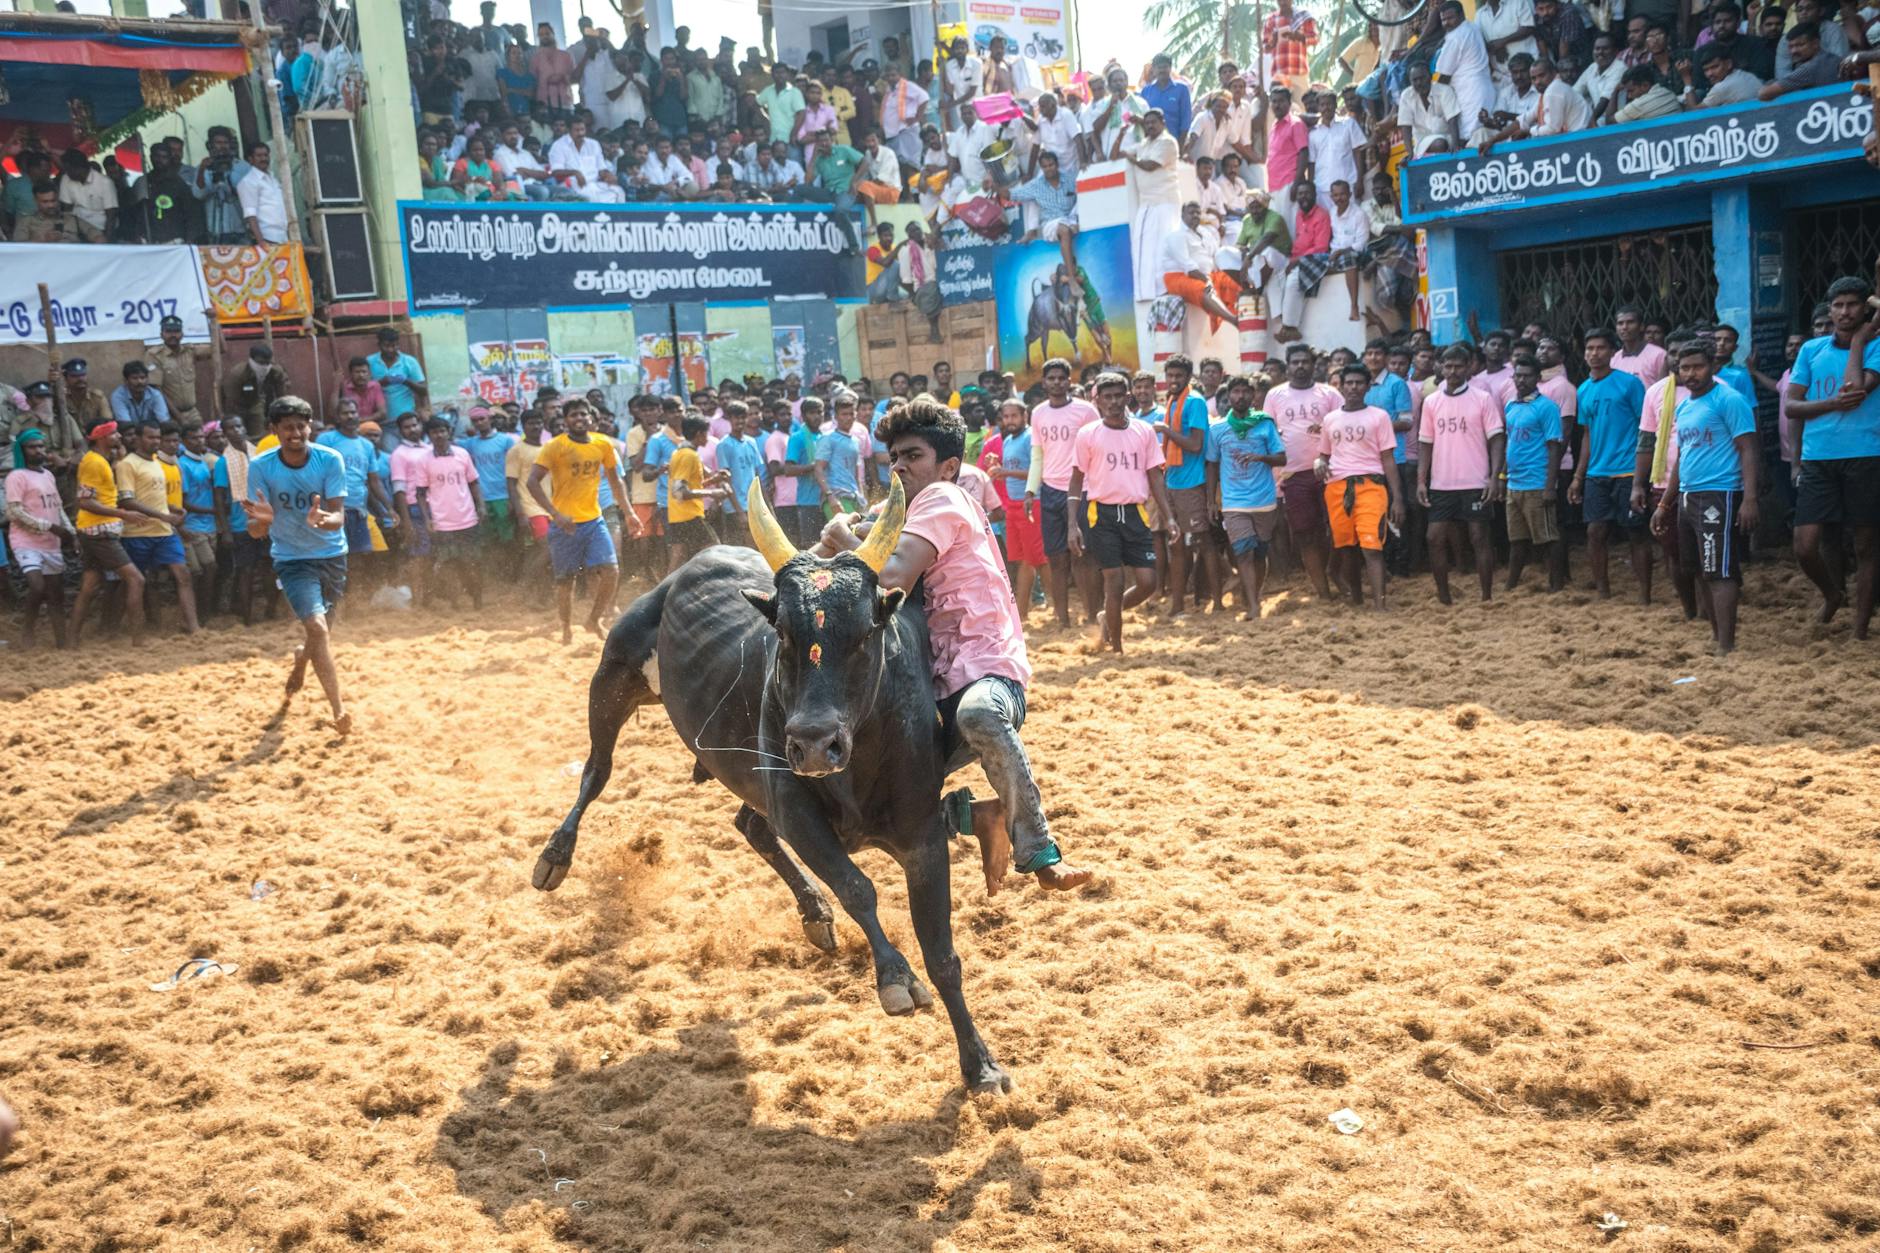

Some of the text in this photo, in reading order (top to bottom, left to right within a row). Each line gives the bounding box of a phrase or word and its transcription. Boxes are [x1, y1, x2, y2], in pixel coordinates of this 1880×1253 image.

[1428, 152, 1602, 202] ஜல்லிக்கட்டு
[1617, 117, 1780, 180] விழாவிற்கு
[121, 298, 178, 325] 2017
[1435, 294, 1448, 314] 2
[1285, 403, 1322, 422] 948
[1040, 425, 1070, 442] 930
[1332, 425, 1367, 444] 939
[1437, 416, 1468, 434] 954
[1107, 452, 1140, 471] 941
[436, 472, 461, 486] 961
